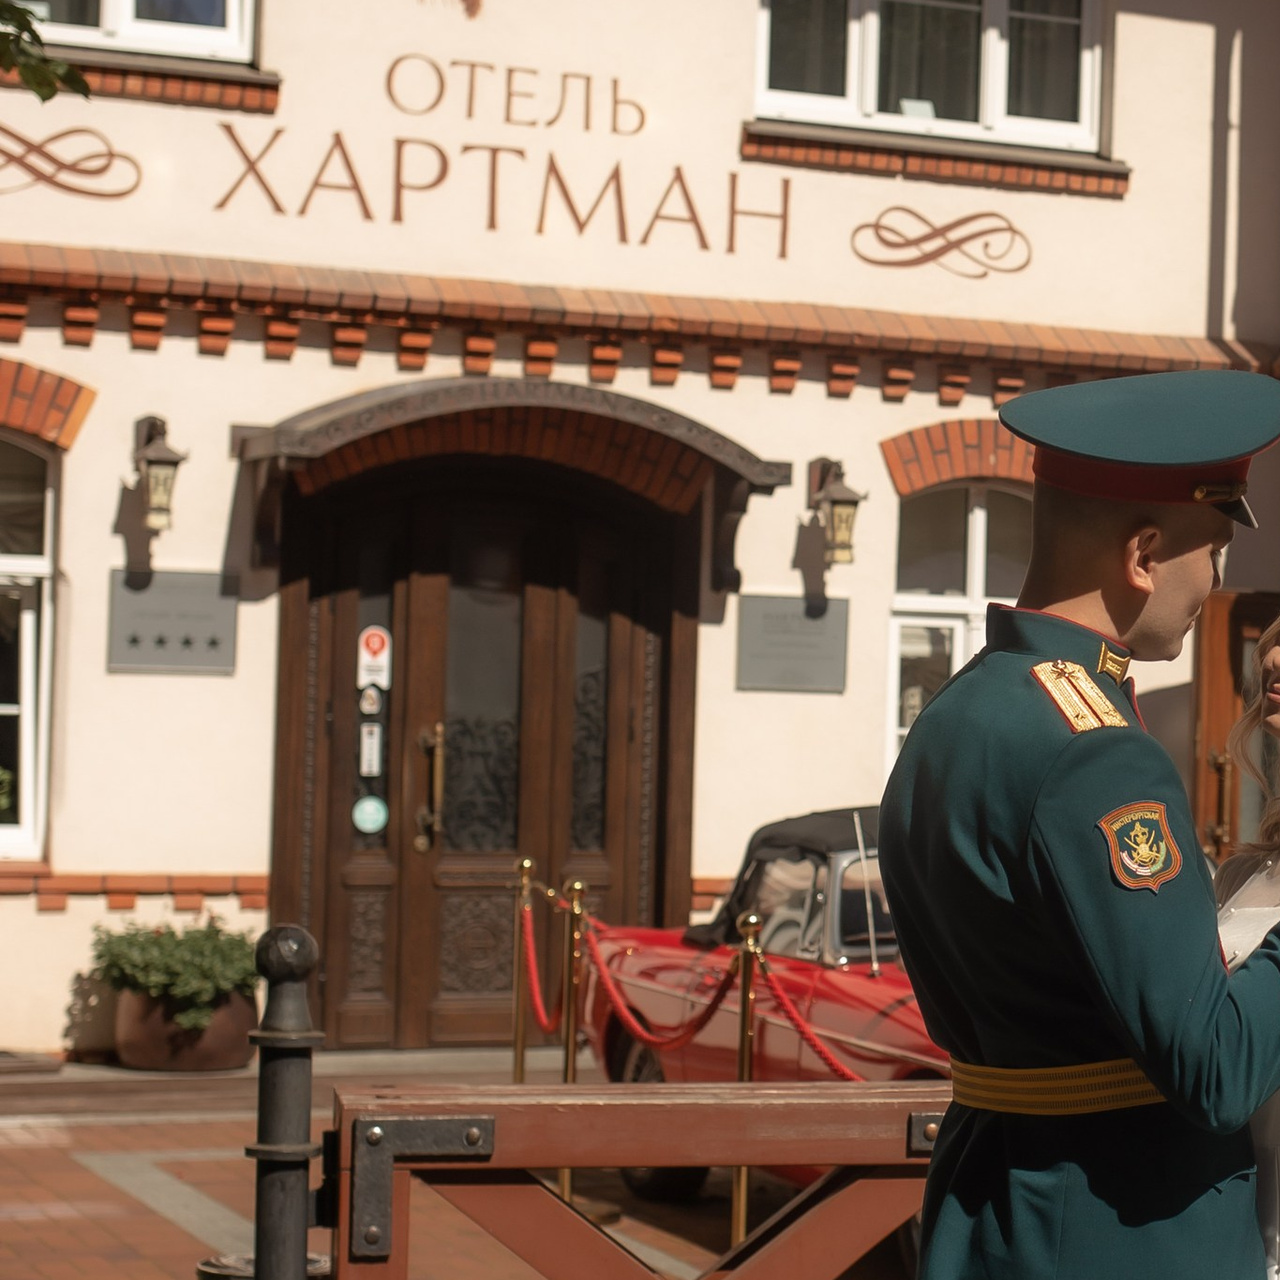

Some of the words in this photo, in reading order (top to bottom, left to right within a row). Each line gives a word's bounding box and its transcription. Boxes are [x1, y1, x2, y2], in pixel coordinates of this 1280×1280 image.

[385, 54, 647, 137] ОТЕЛЬ
[213, 121, 793, 261] ХАРТМАН
[480, 381, 618, 414] HARTMAN
